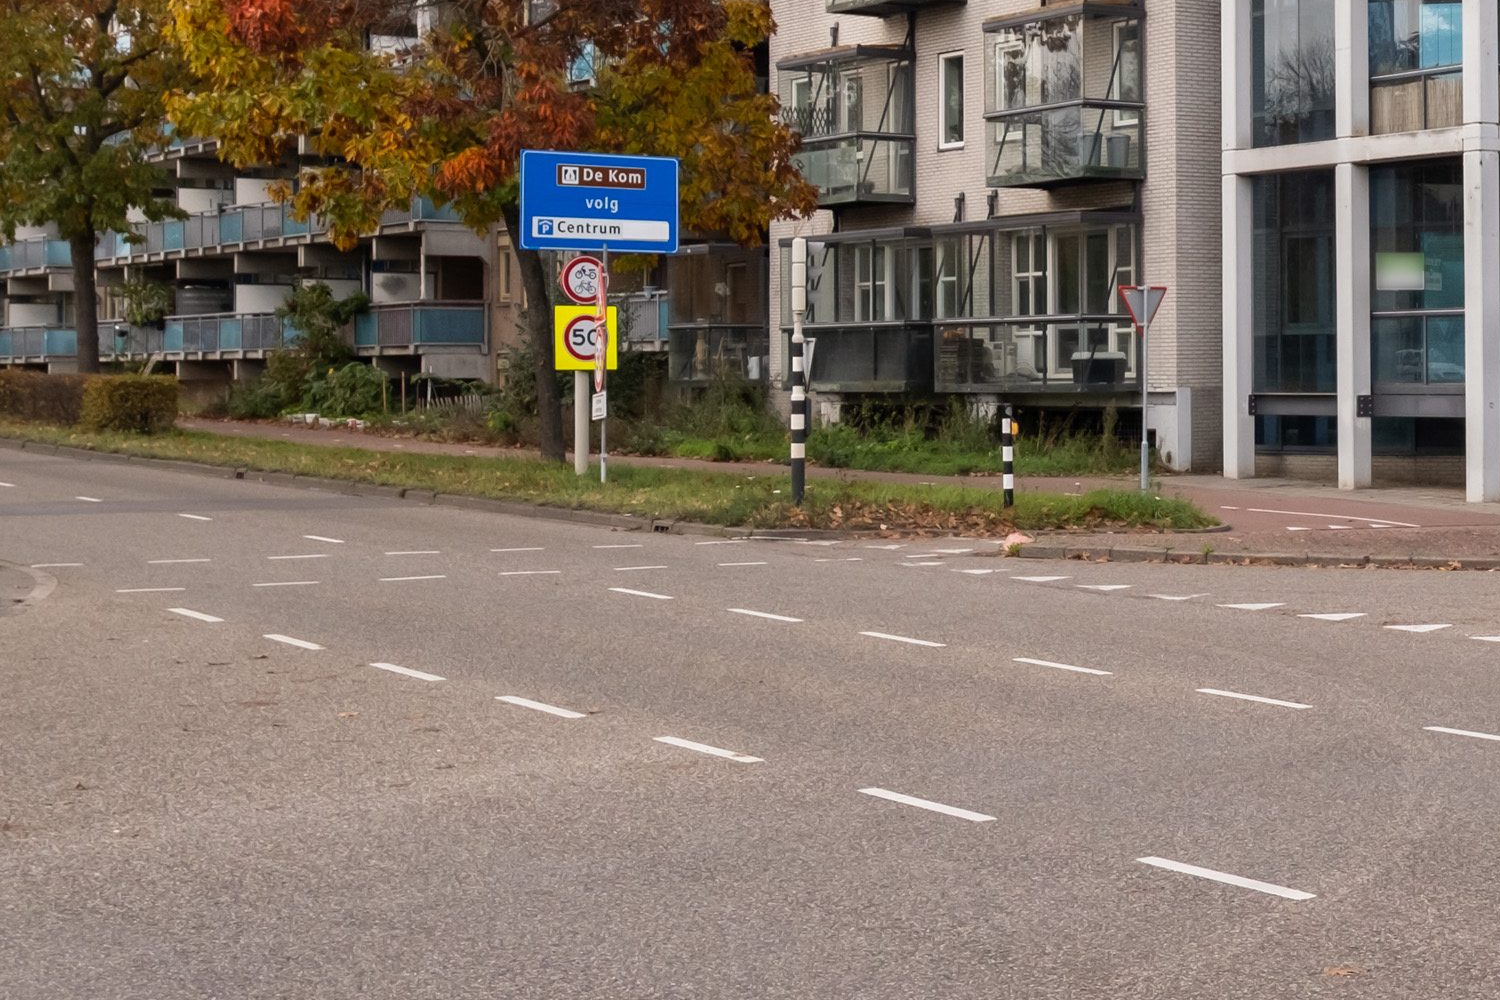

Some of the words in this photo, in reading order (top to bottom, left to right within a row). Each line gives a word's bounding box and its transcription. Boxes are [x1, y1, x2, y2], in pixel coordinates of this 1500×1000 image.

[583, 168, 603, 182] De
[608, 169, 642, 184] Kom
[585, 196, 619, 214] volg
[557, 220, 621, 235] Centrum
